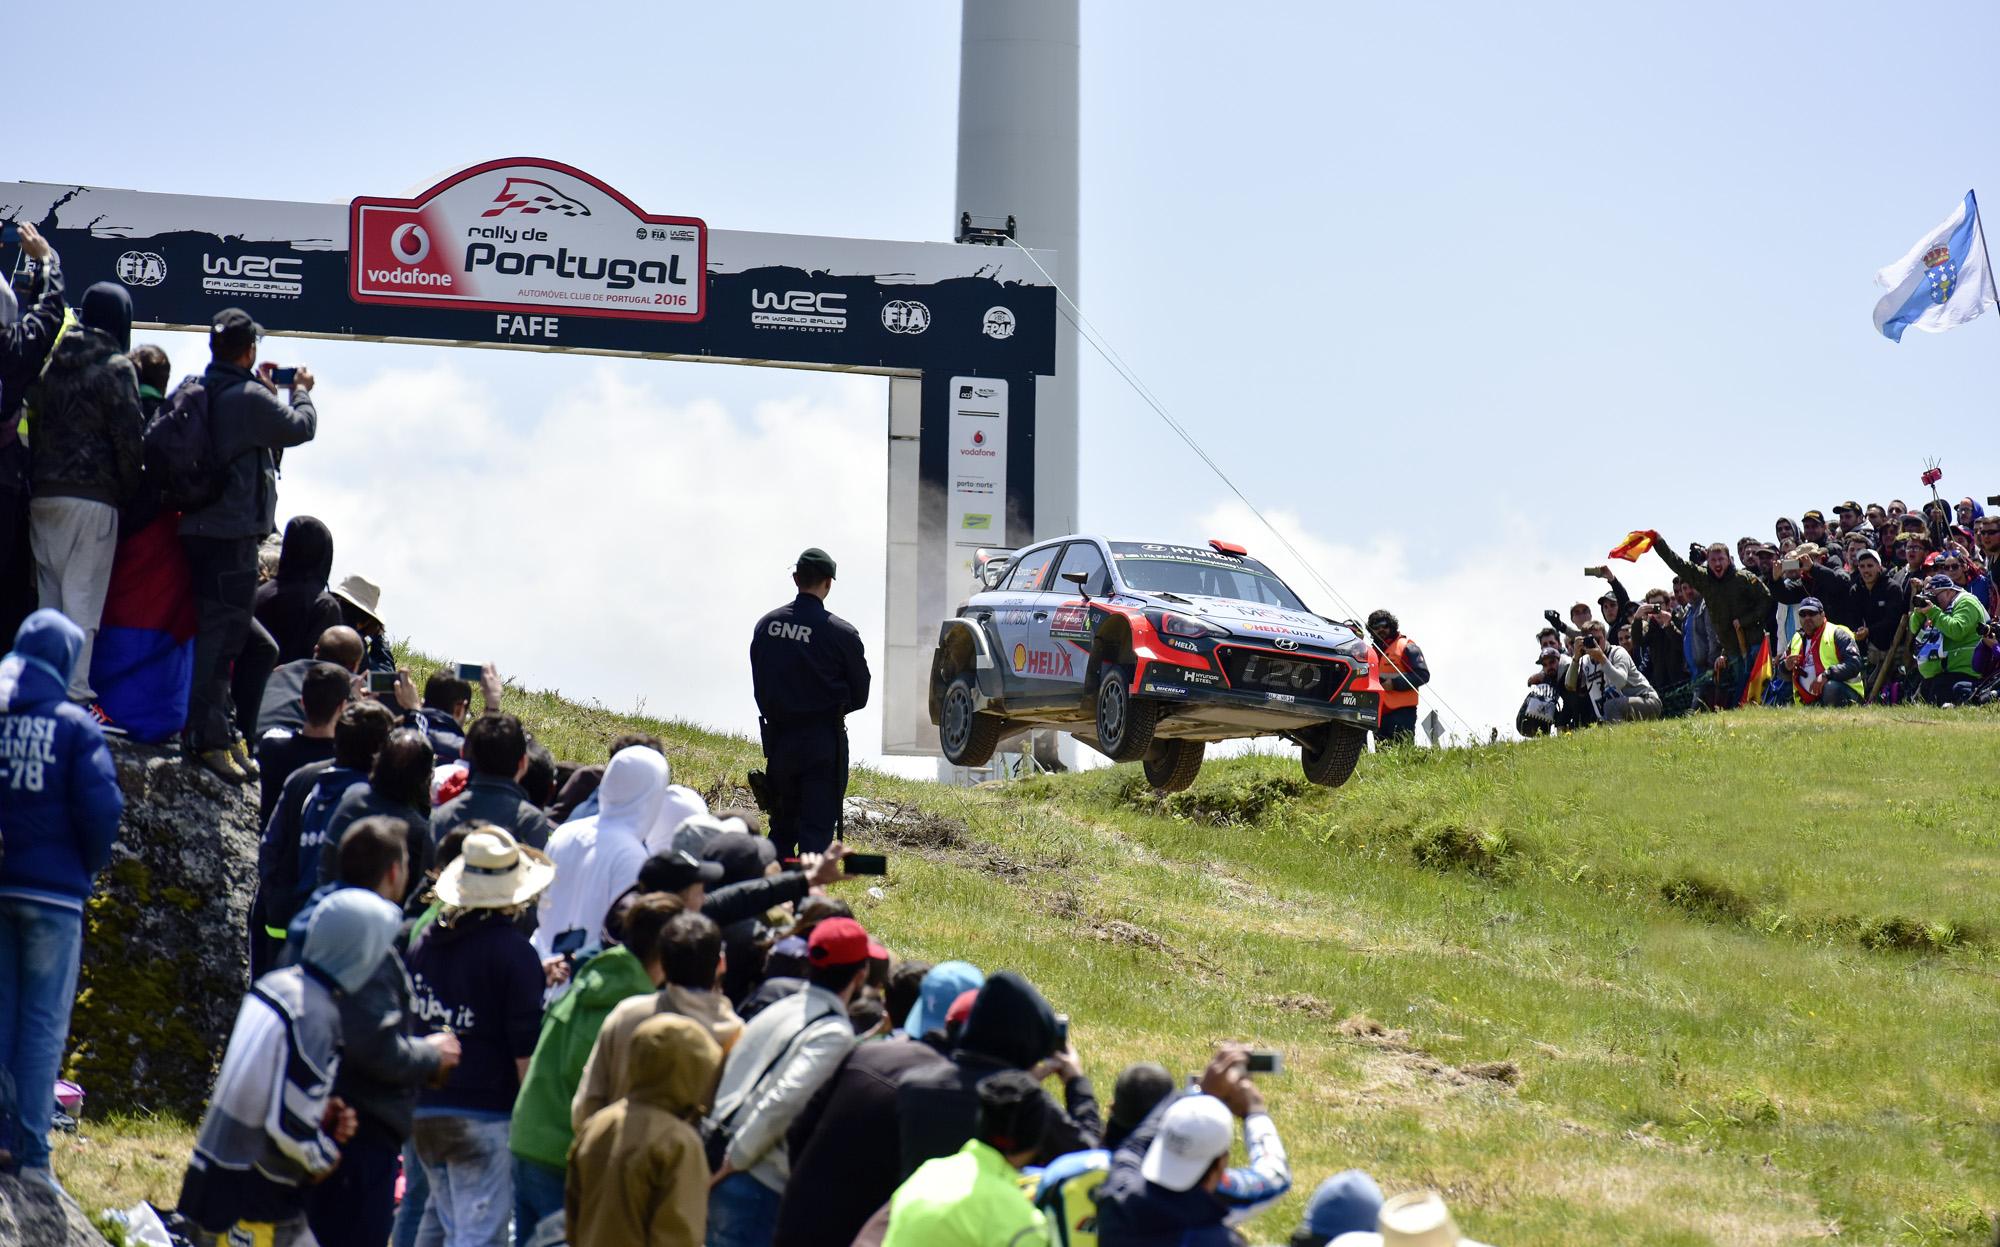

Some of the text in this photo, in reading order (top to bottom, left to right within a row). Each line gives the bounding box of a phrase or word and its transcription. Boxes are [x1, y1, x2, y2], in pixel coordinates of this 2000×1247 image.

[467, 225, 548, 243] rally de
[203, 253, 303, 280] WRC
[464, 242, 687, 289] Portugal
[367, 267, 452, 287] vodafone
[205, 290, 300, 300] CHAMPIONSHIP
[570, 292, 591, 301] CLUB
[592, 294, 604, 302] DE
[606, 294, 652, 305] PORTUGAL
[654, 293, 687, 306] 2016
[752, 288, 848, 314] WRC
[496, 314, 560, 338] FAFE
[754, 324, 845, 334] CHAMPIONSHIP
[982, 322, 1016, 336] FPAK
[960, 449, 996, 457] vodafone
[1170, 546, 1244, 564] HYUNDAI
[767, 620, 813, 643] GNR
[1254, 625, 1325, 640] HELIX ULTRA
[1174, 640, 1199, 652] HELIX
[1028, 649, 1073, 677] HELIX
[1156, 686, 1187, 694] MICHELIN
[0, 715, 57, 741] FOSI
[456, 1004, 475, 1028] it
